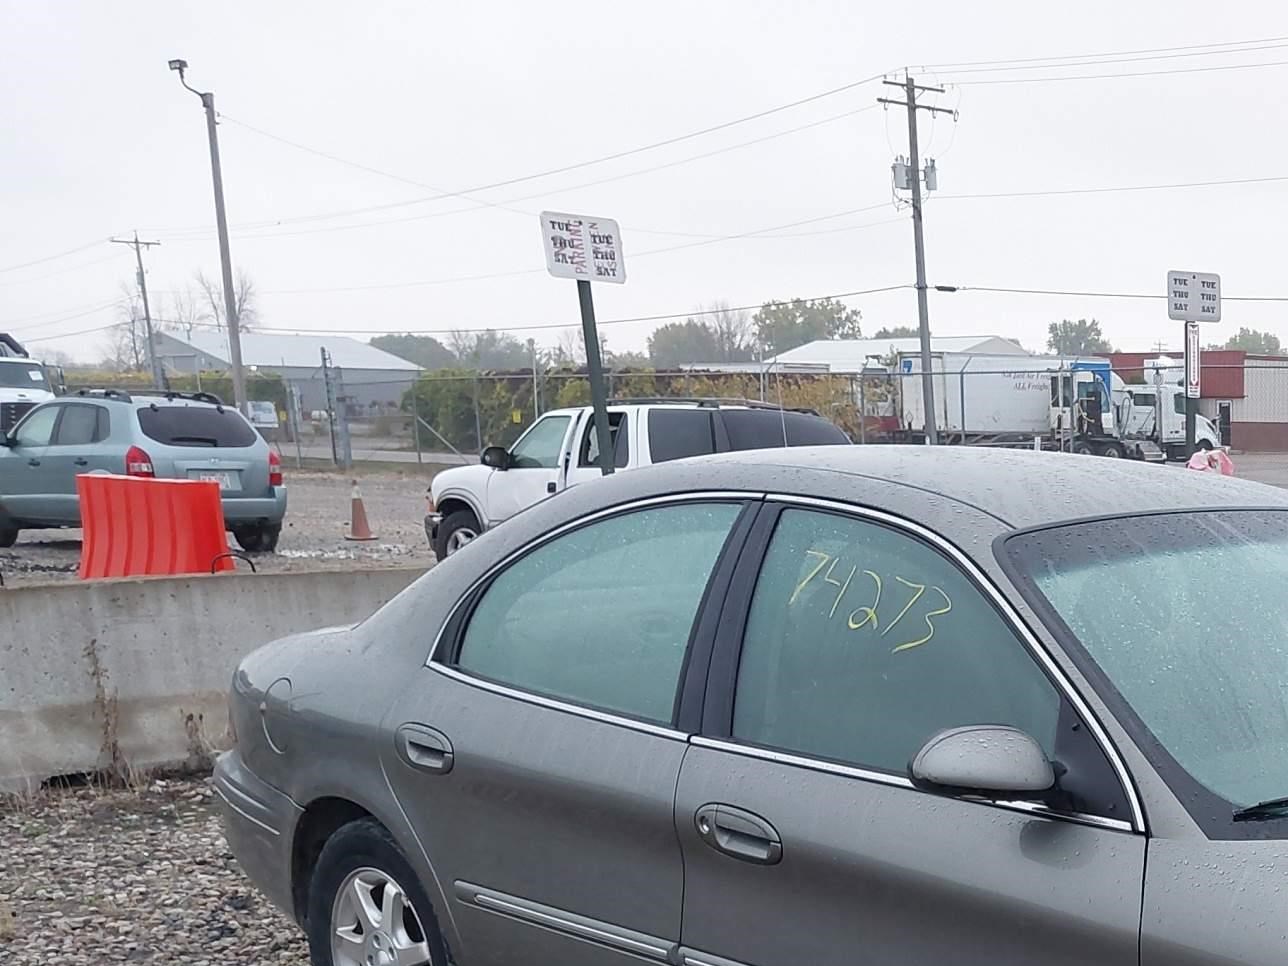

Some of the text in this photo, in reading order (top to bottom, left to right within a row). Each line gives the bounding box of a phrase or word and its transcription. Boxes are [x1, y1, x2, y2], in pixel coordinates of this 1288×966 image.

[1173, 278, 1188, 286] TUE
[1201, 281, 1216, 289] TUE
[1173, 290, 1189, 298] THU
[1174, 303, 1188, 311] SAT
[1201, 306, 1216, 314] SAT
[788, 550, 952, 654] 74273
